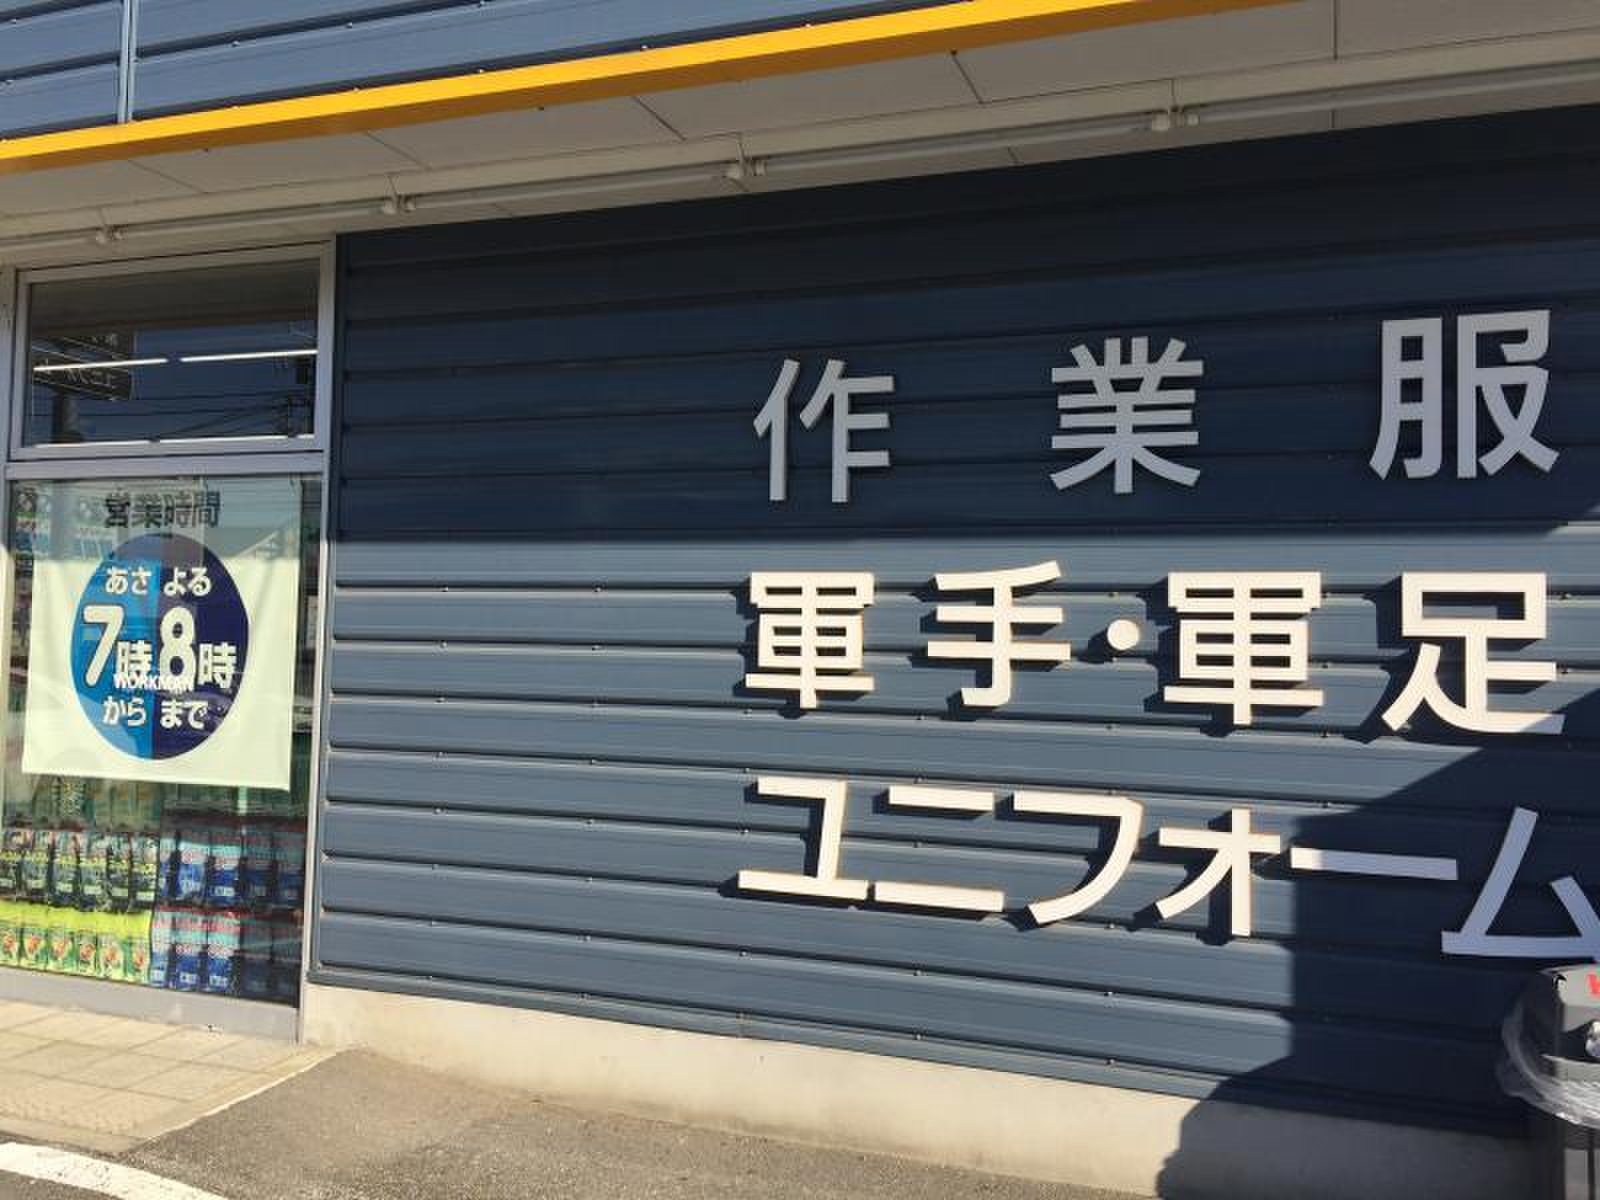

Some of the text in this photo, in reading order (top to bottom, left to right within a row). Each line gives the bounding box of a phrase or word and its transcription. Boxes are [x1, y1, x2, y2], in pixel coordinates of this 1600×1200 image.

[753, 308, 1560, 505] 作業服
[105, 489, 221, 529] 営業時間
[105, 566, 212, 597] あさ よる
[83, 604, 237, 690] 7時 8時
[745, 560, 1565, 736] 軍手・軍足
[102, 697, 209, 729] から まで
[737, 775, 1600, 961] ユニフォーム
